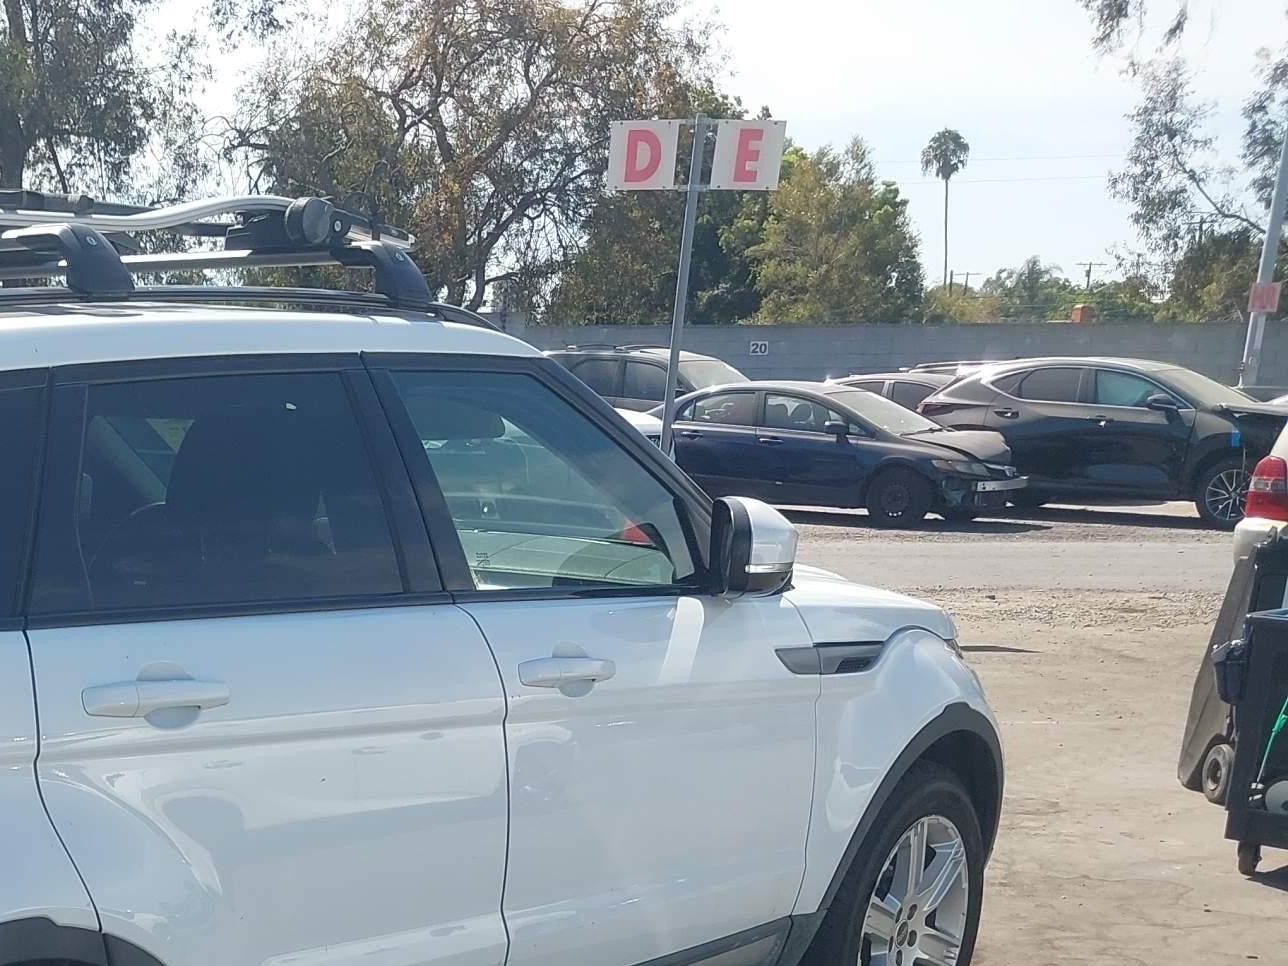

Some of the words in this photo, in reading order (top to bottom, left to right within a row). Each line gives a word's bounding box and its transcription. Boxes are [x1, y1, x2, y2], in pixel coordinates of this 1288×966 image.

[623, 128, 662, 183] D
[733, 128, 765, 183] E
[751, 342, 768, 354] 20
